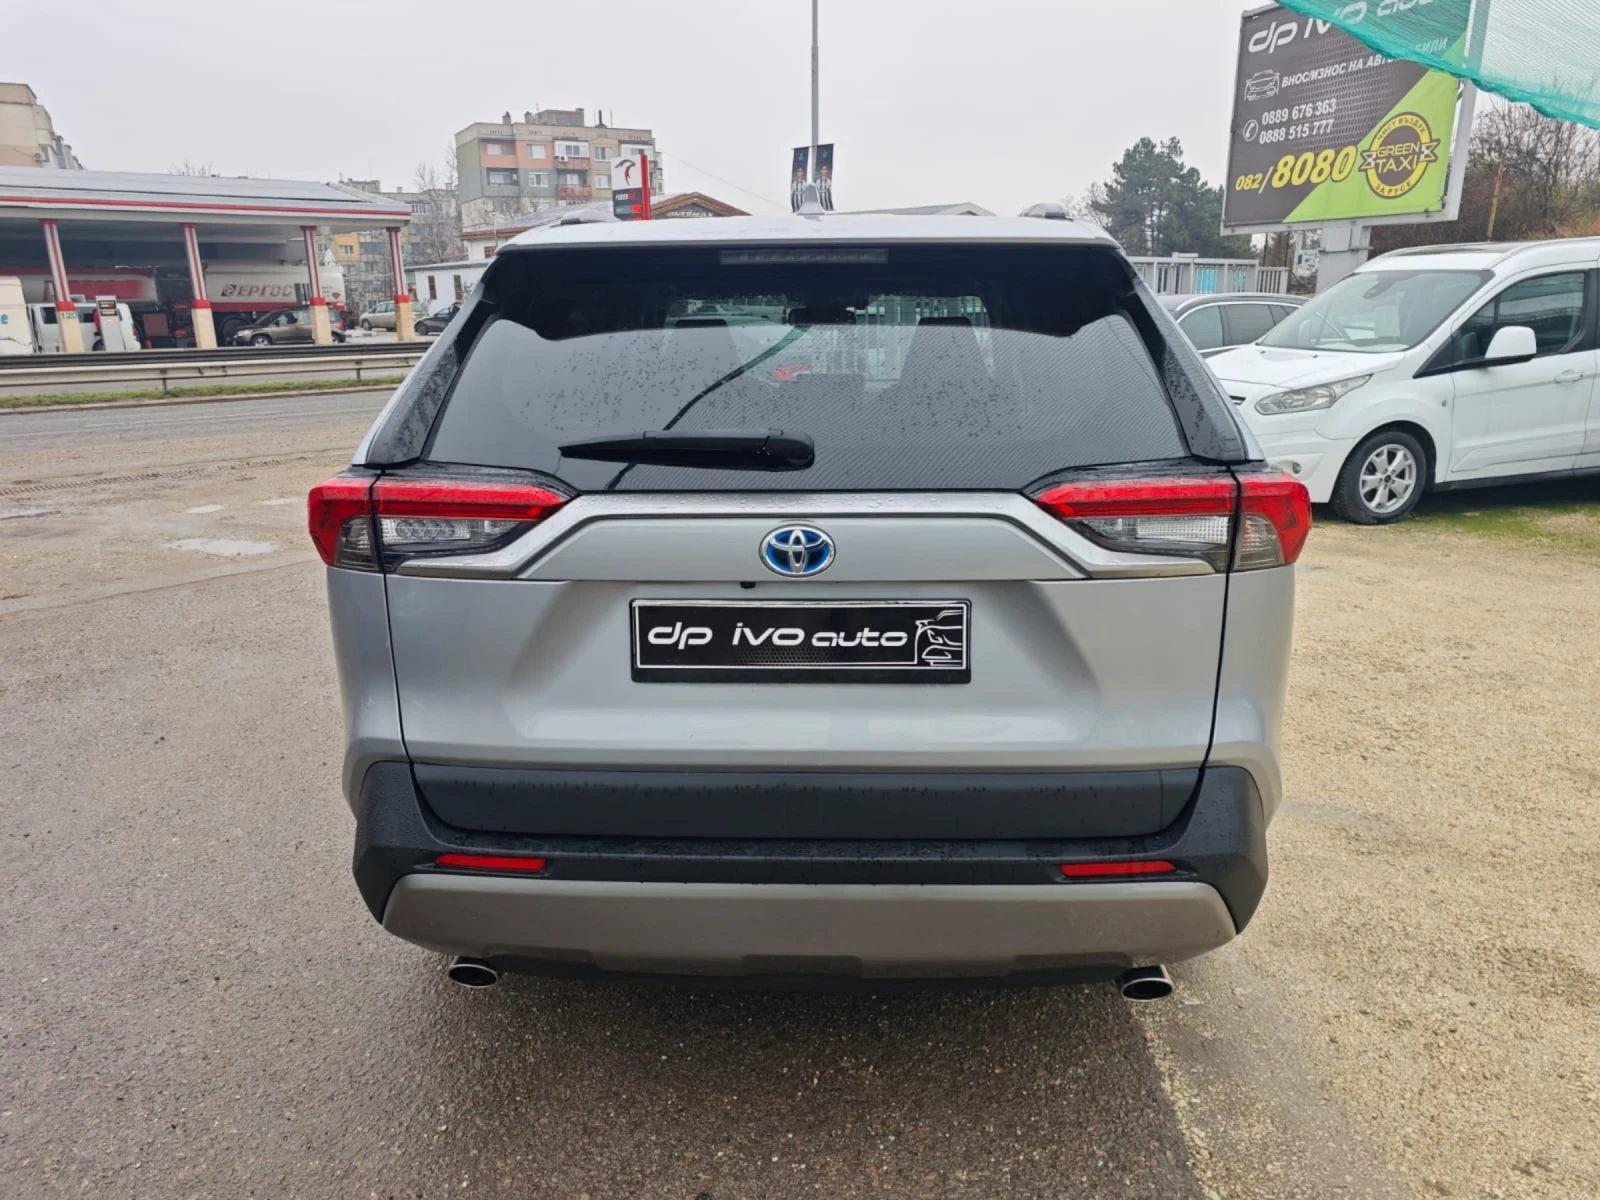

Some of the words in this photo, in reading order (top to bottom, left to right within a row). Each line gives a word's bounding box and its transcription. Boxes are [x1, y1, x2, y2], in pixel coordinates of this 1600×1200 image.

[1248, 21, 1298, 53] dp
[1281, 62, 1346, 88] ВНОС/ИЗНОС
[1348, 59, 1364, 74] НА
[1262, 108, 1288, 125] 0889
[1292, 103, 1313, 120] 676
[1315, 98, 1337, 115] 363
[1259, 127, 1286, 144] 0888
[1288, 123, 1309, 140] 515
[1313, 119, 1335, 136] 777
[1377, 141, 1421, 158] GREEN
[1235, 145, 1358, 194] 082/8080
[1376, 155, 1418, 174] TAXI
[1387, 181, 1412, 195] РУСЕ
[648, 621, 713, 650] dp
[732, 622, 805, 646] ivo
[811, 627, 908, 647] auto
